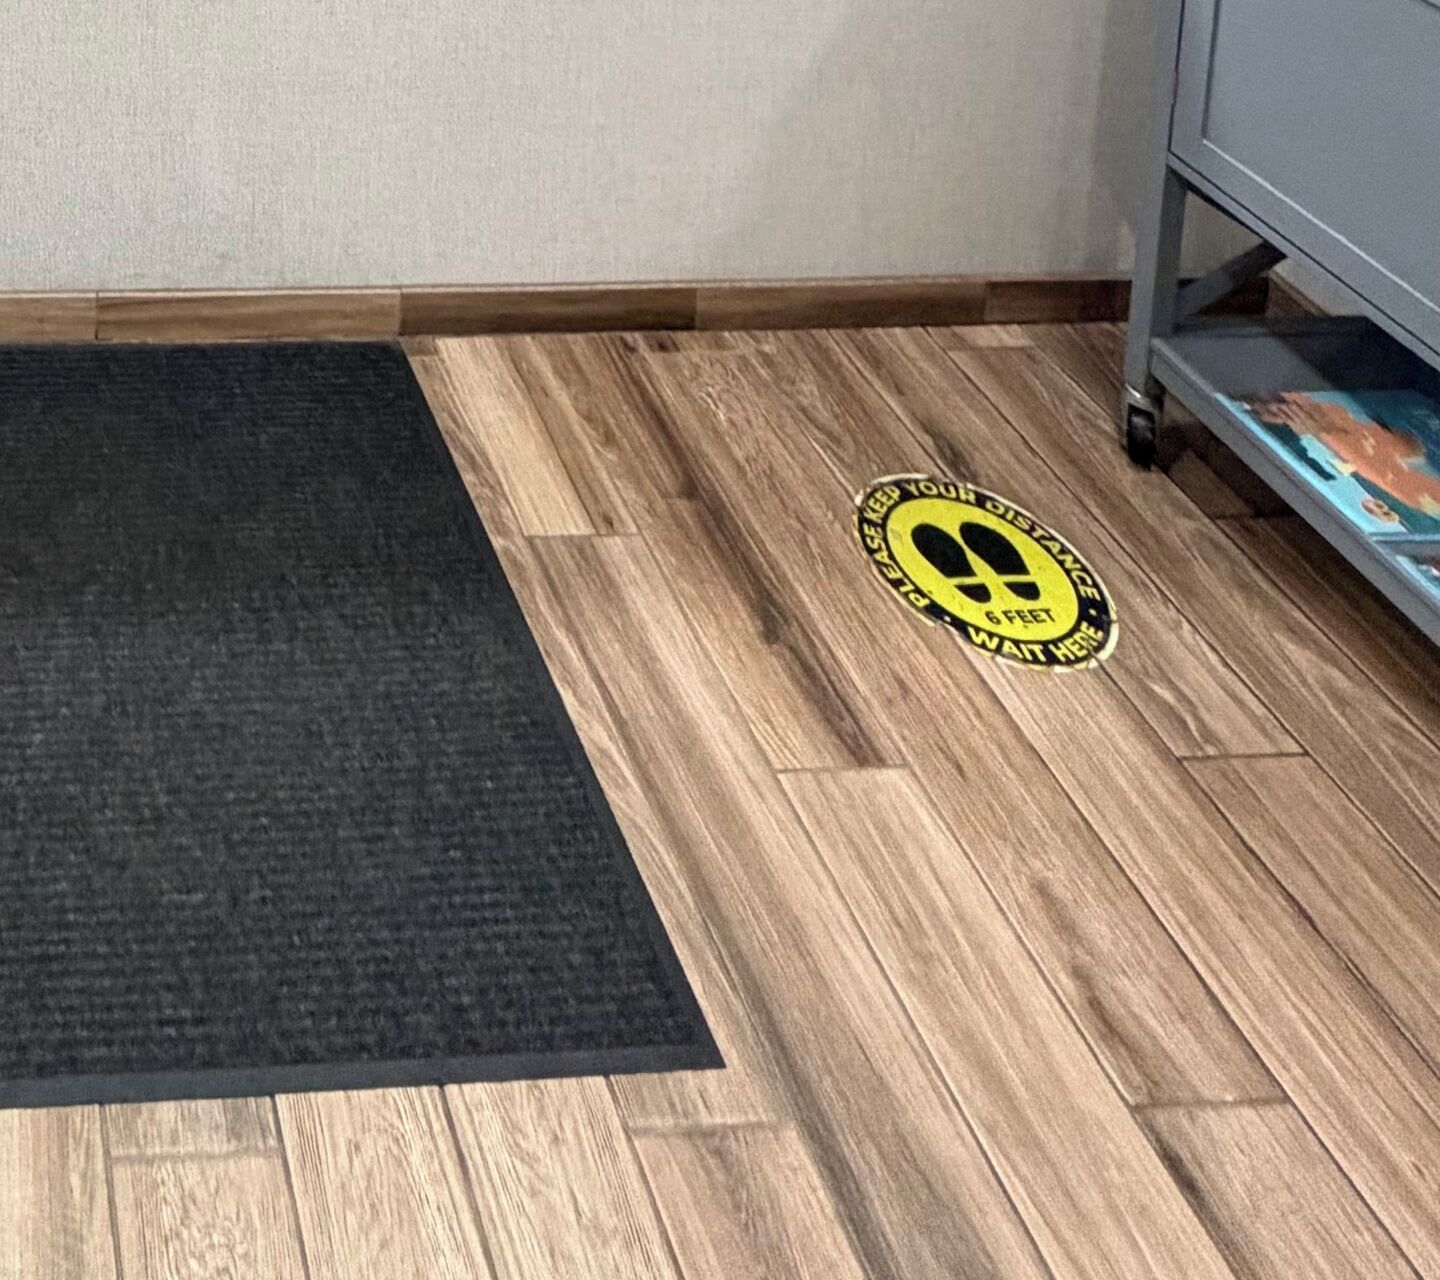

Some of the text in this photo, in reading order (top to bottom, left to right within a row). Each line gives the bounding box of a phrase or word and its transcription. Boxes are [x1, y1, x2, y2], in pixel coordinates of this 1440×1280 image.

[863, 480, 1101, 609] PLEASE KEEP YOUR DISTANCE
[984, 608, 1056, 625] 6 FEET
[968, 621, 1104, 662] WAIT HERE
